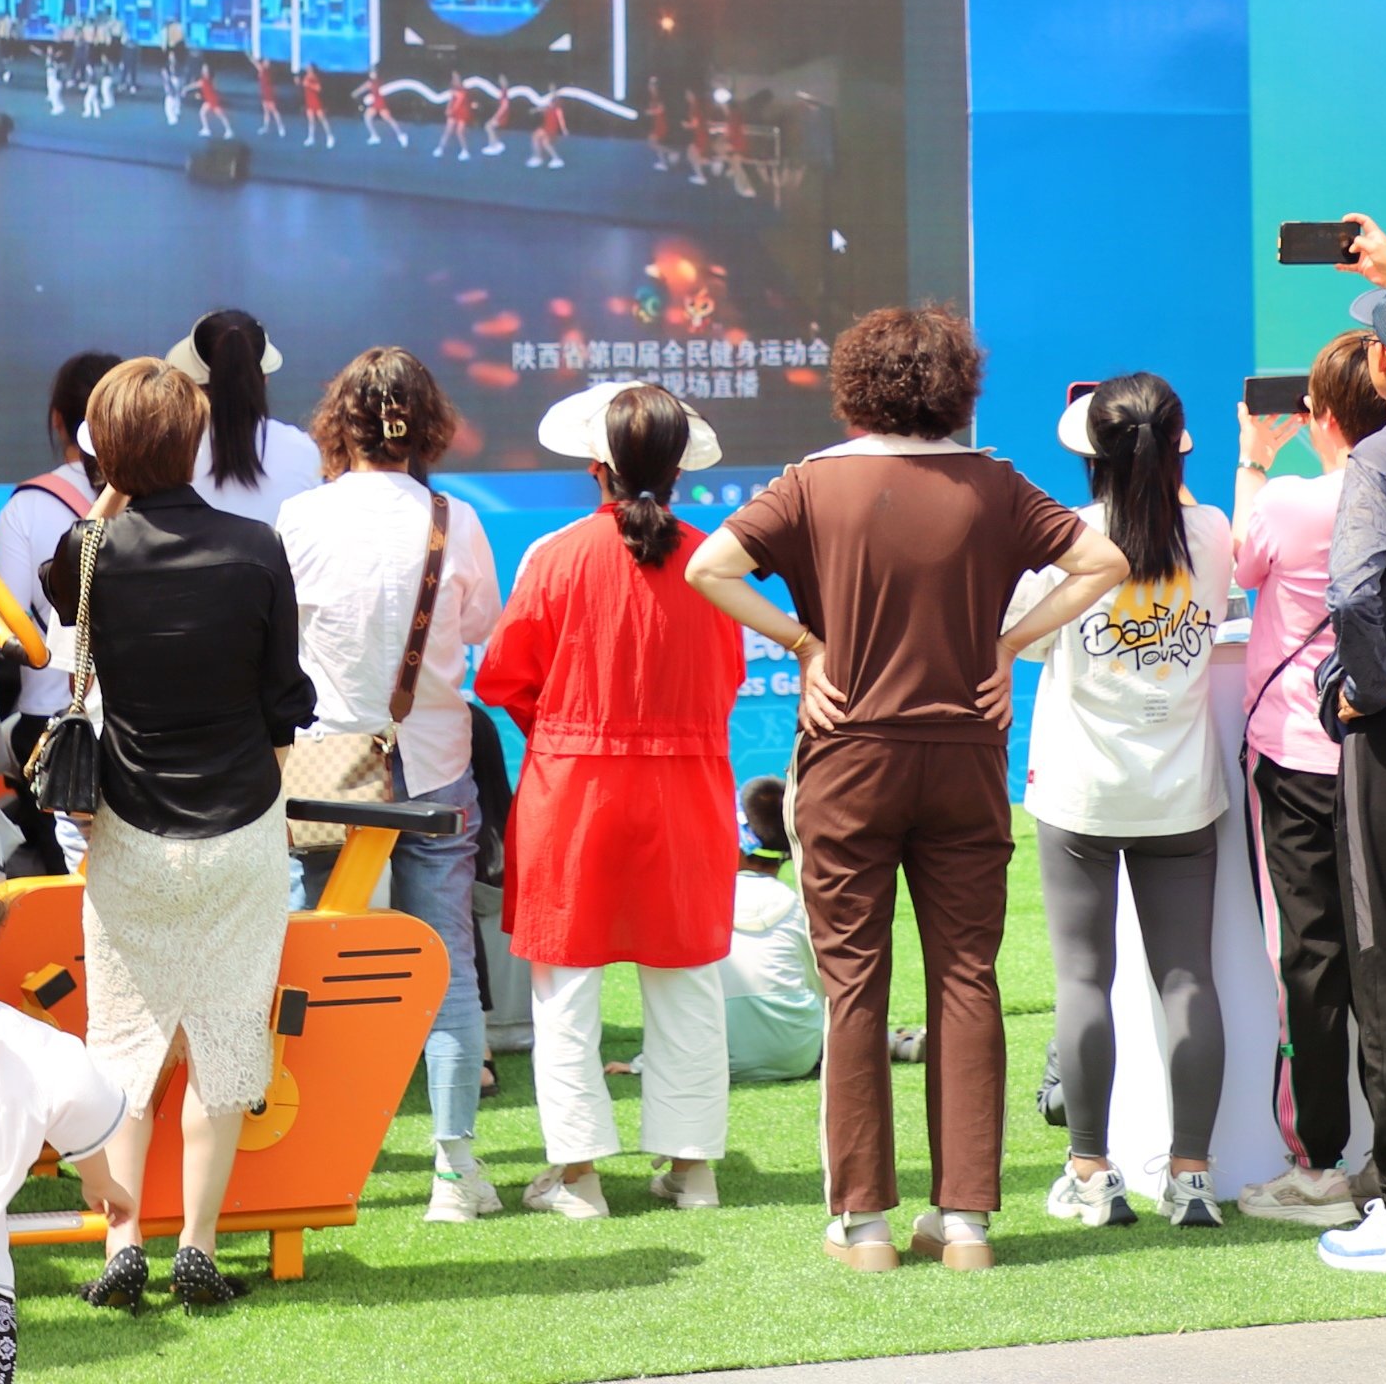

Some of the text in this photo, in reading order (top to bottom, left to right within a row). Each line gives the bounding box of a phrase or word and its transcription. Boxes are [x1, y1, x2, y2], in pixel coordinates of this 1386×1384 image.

[511, 338, 831, 370] 陕西省第四届全民健身运动会
